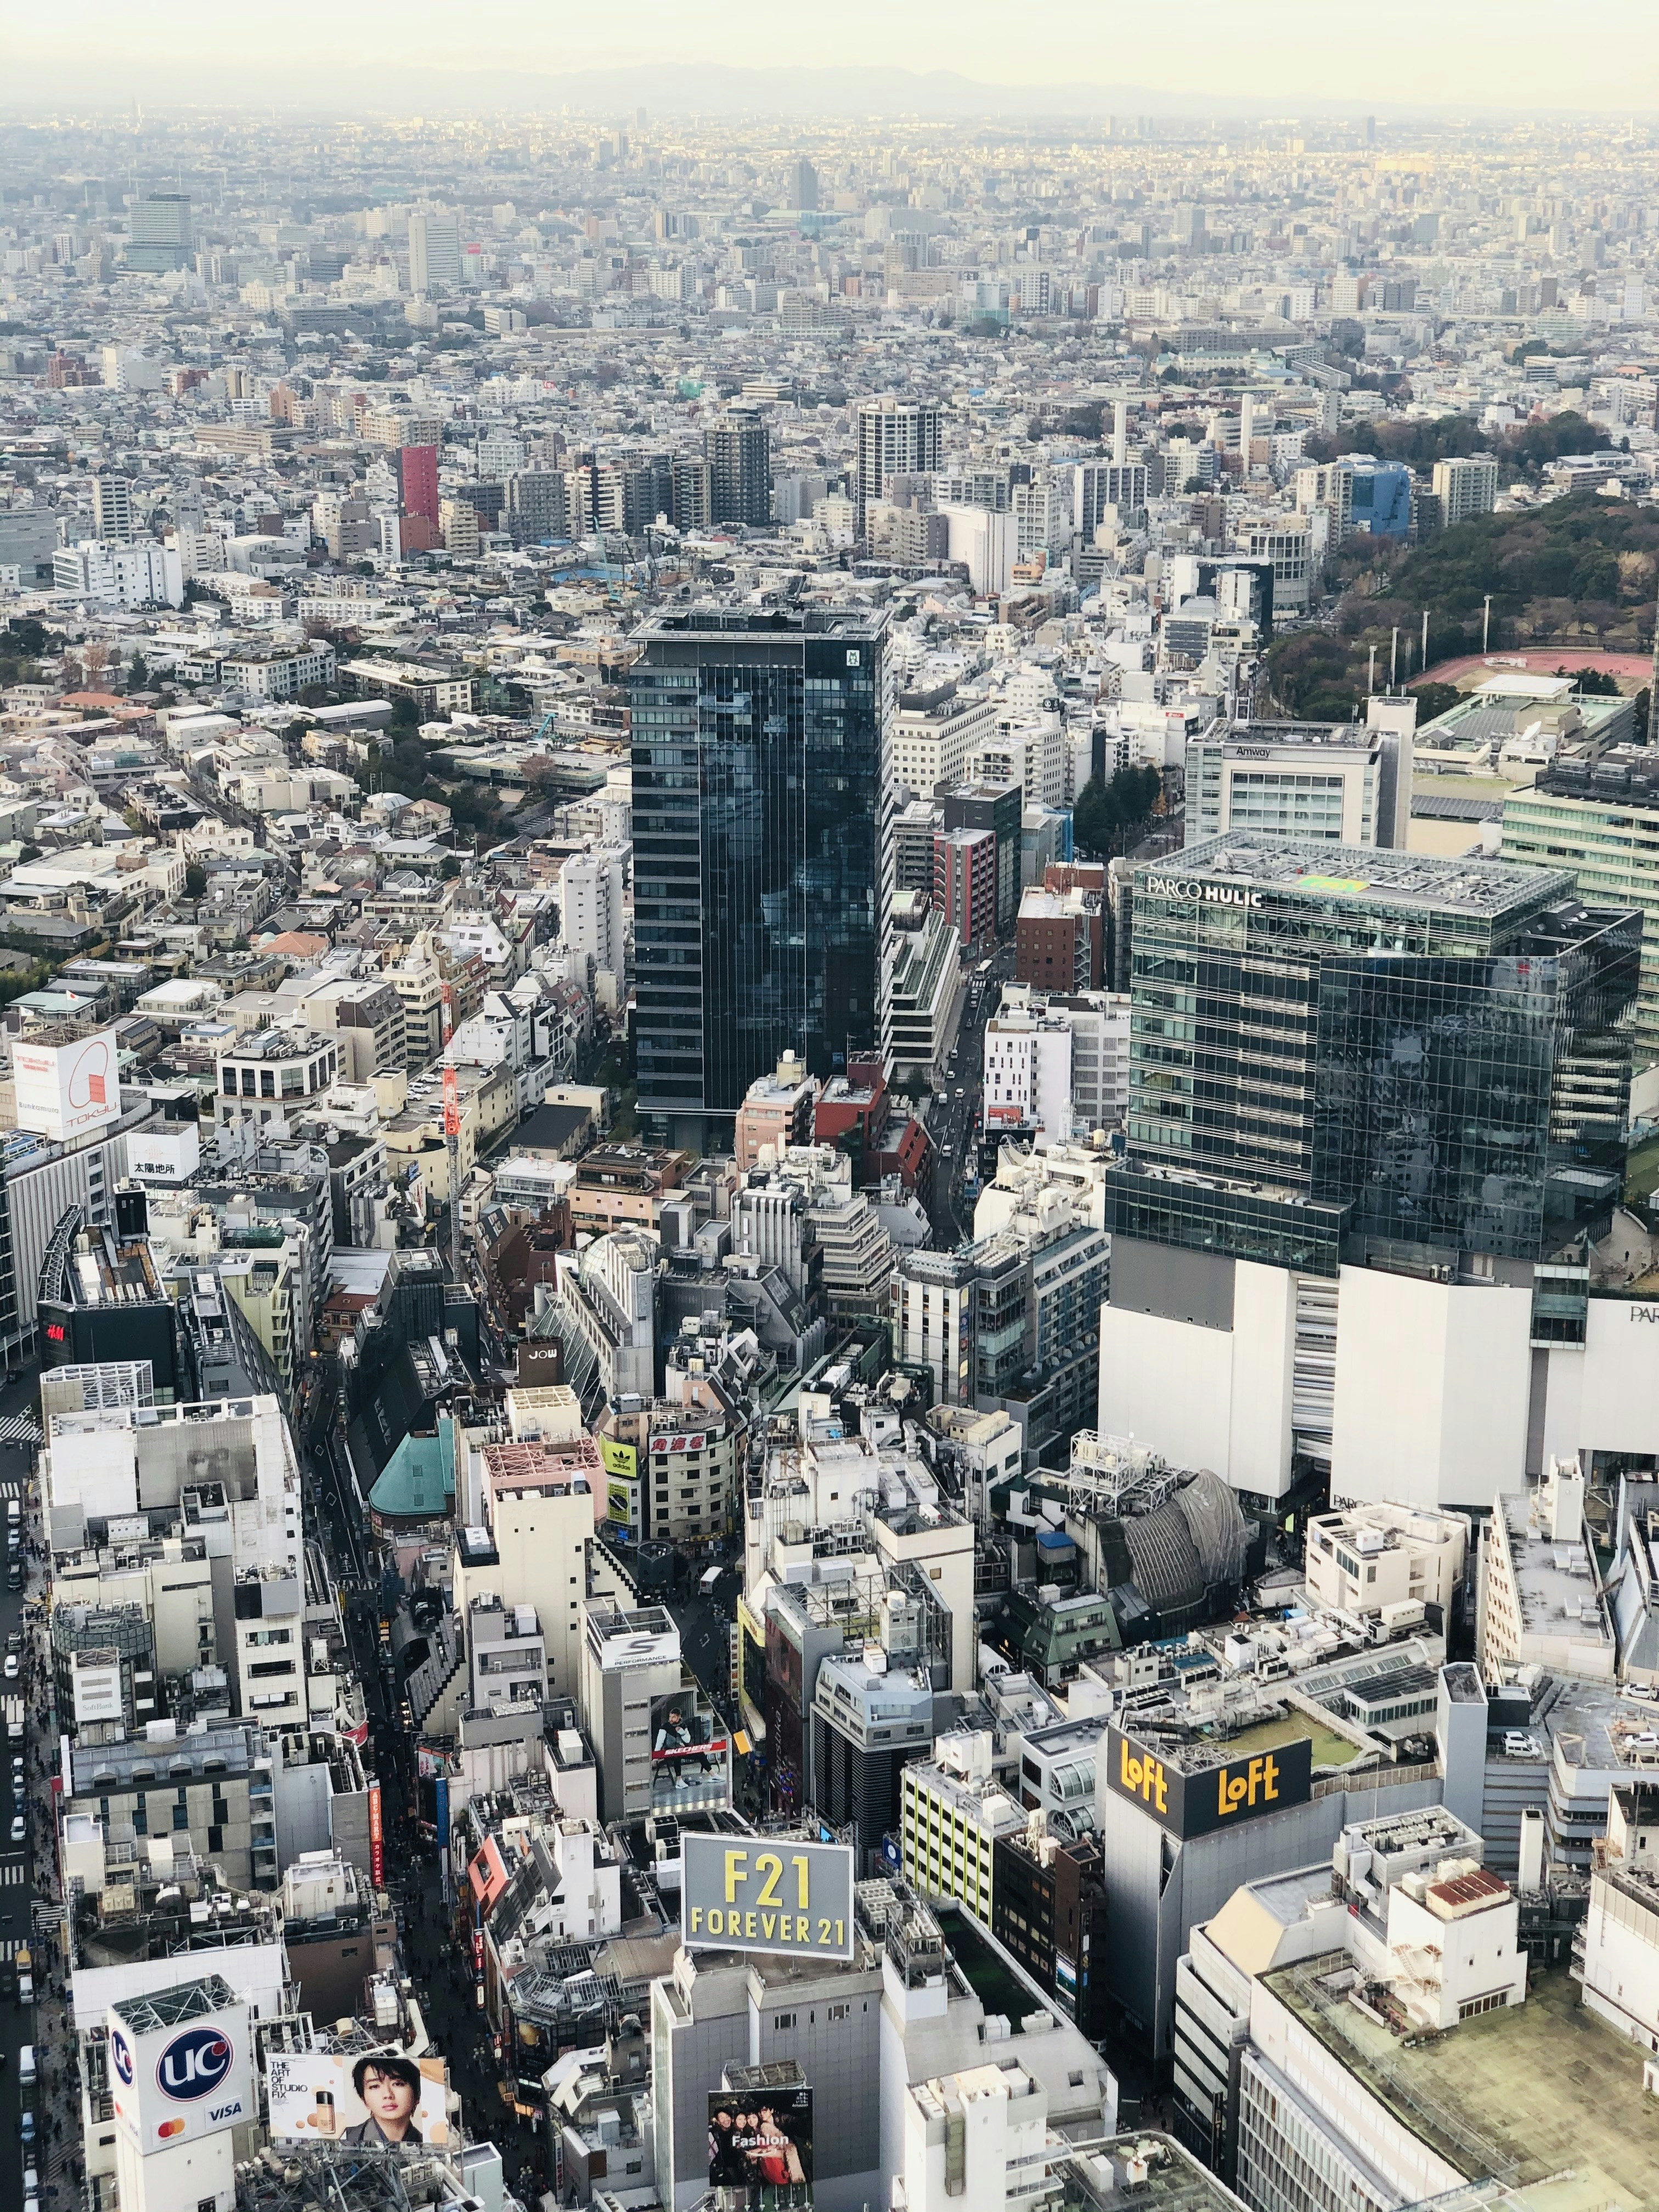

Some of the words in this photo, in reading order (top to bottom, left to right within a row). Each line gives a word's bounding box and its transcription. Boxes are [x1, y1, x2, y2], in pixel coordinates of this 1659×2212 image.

[1236, 746, 1271, 758] Amway
[1148, 876, 1202, 900] PARCO
[1205, 885, 1262, 907] HULIC
[19, 1101, 59, 1114] Bunkamura
[66, 1102, 117, 1127] TOKYU
[134, 1163, 175, 1175] 太陽地所
[612, 1463, 631, 1471] adidas
[614, 1655, 667, 1666] PERFORMANCE
[83, 1702, 114, 1711] SoftBank
[664, 1742, 713, 1756] SKECHERS
[725, 1849, 809, 1910] F21
[691, 1906, 811, 1943] FOREVER
[818, 1918, 844, 1946] 21
[164, 2040, 228, 2086] UC
[270, 2061, 290, 2069] THE
[271, 2069, 291, 2077] ART
[272, 2083, 308, 2092] STUDIO
[272, 2091, 287, 2099] FIX
[208, 2102, 242, 2121] VISA
[732, 2134, 789, 2147] Fashion
